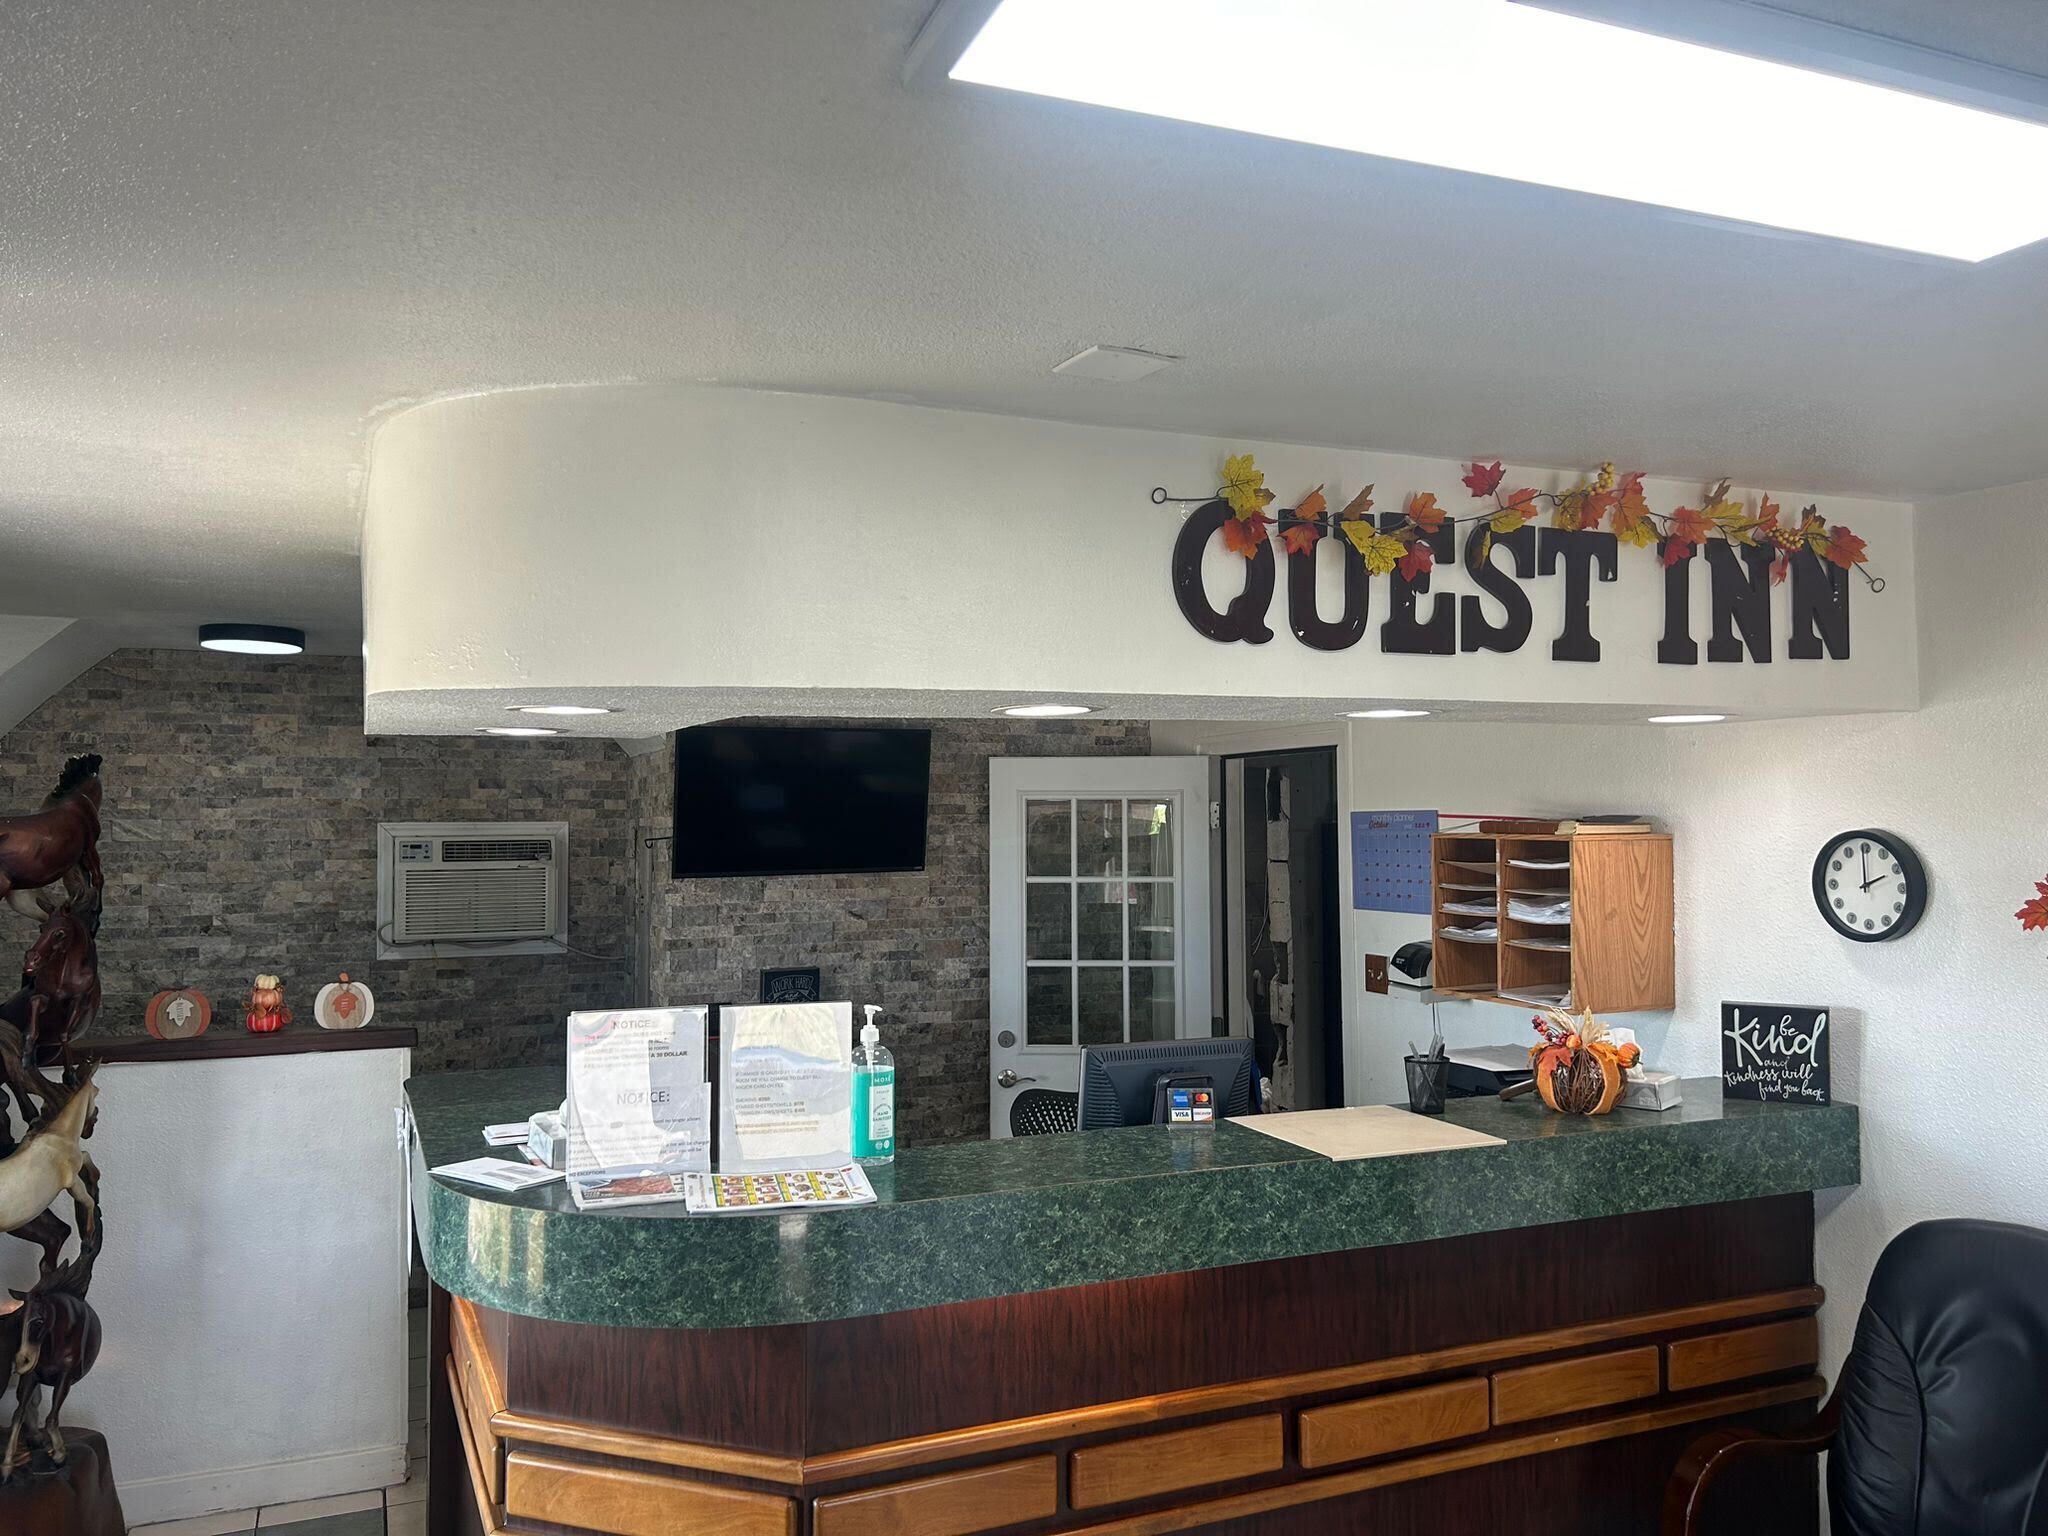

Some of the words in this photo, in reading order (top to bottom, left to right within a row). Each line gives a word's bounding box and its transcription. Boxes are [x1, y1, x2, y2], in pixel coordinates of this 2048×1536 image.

[1172, 500, 1618, 663] QUEST
[1657, 534, 1850, 665] INN
[1780, 1014, 1799, 1036] be
[664, 1050, 688, 1058] DOLLAR
[1763, 1056, 1791, 1070] and
[1781, 1063, 1814, 1080] will
[1759, 1079, 1783, 1102] find
[1783, 1083, 1801, 1099] you
[1801, 1079, 1826, 1102] back
